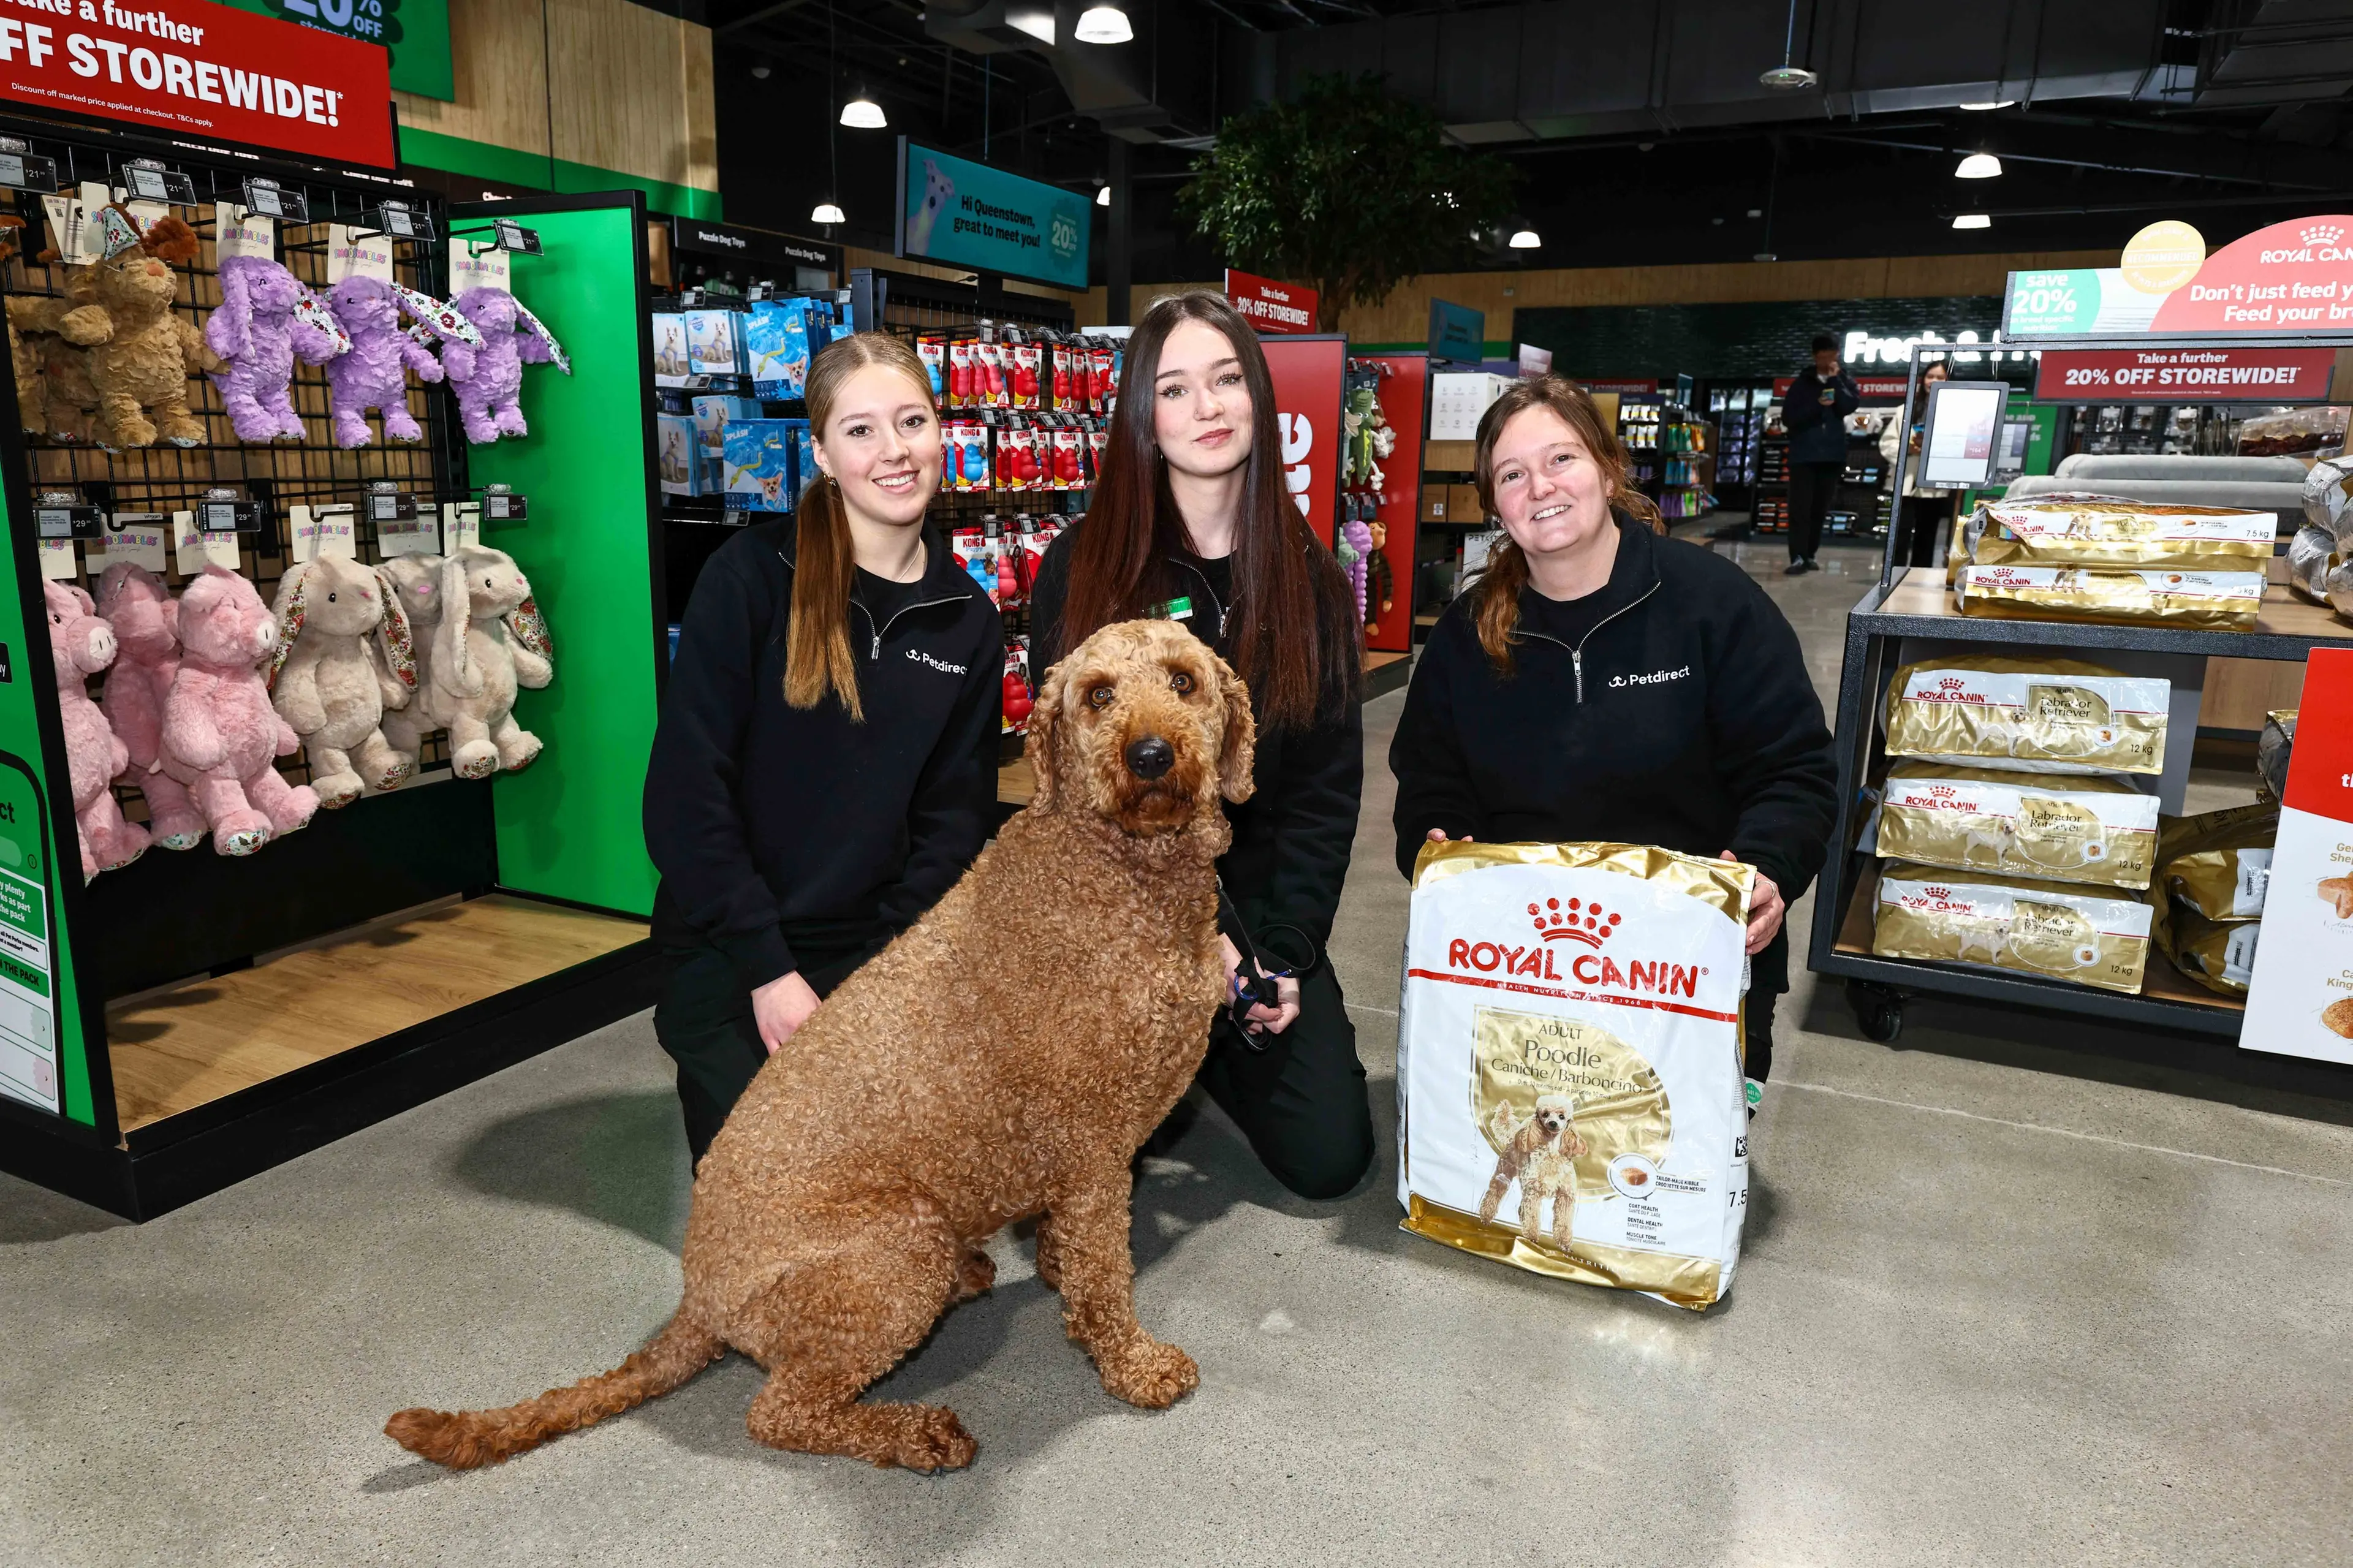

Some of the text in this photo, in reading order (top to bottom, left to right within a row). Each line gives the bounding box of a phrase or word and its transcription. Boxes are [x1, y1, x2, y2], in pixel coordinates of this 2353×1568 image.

[79, 0, 203, 46] a further
[353, 15, 382, 38] OFF
[11, 82, 45, 96] Discount
[58, 91, 86, 103] marked
[88, 97, 105, 107] price
[107, 100, 133, 112] applied
[143, 107, 175, 119] checkout.
[176, 114, 194, 123] T&Cs
[194, 117, 214, 127] apply.
[961, 195, 972, 211] Hi
[975, 199, 1036, 229] Queenstown,
[699, 231, 746, 248] Puzzle Dog Toys
[953, 217, 1040, 249] great to meet you!
[334, 248, 387, 265] SMOOSHABLES
[803, 249, 813, 260] Dog
[814, 252, 826, 262] Toys
[2126, 251, 2199, 264] RECOMMENDED
[2260, 248, 2314, 264] ROYAL
[2026, 273, 2069, 288] save
[1260, 286, 1271, 298] Take
[2190, 281, 2337, 303] Don't just feed
[1237, 297, 1268, 317] 20% OFF
[2010, 288, 2077, 314] 20%
[2224, 304, 2273, 322] Feed
[2276, 308, 2325, 324] your
[2137, 353, 2167, 364] Take
[2180, 352, 2229, 364] further
[2065, 368, 2110, 385] 20%
[2115, 368, 2155, 385] OFF
[725, 428, 749, 442] SPLASH
[298, 525, 349, 539] SMOOSHABLES
[1032, 532, 1050, 543] KONG
[2259, 529, 2269, 539] kg
[93, 534, 158, 547] SMOOSHABLES
[963, 538, 980, 547] KONG
[1976, 576, 2031, 586] ROYAL CANIN
[922, 653, 967, 676] Petdirec
[1629, 665, 1690, 686] Petdirect
[1917, 691, 1985, 703] ROYAL CANIN
[2040, 707, 2091, 718] Retriever
[2130, 744, 2153, 755] 12 kg
[1906, 795, 1977, 812] ROYAL CANIN
[2032, 810, 2082, 822] Labrador
[2130, 860, 2142, 871] kg
[5, 884, 25, 900] plenty
[9, 898, 31, 913] as part
[1901, 895, 1972, 914] ROYAL CANIN
[0, 904, 26, 923] the pack
[1449, 939, 1563, 982] ROYAL
[4, 961, 39, 987] THE PACK
[2122, 966, 2133, 976] kg
[1497, 982, 1529, 991] HEALTH
[1534, 987, 1582, 999] NUTRITION
[1585, 993, 1614, 1003] INCE
[2327, 978, 2353, 991] King
[1539, 1024, 1583, 1040] ADULT
[1525, 1039, 1602, 1069] Poodle
[1491, 1058, 1642, 1094] Caniche / Barboncino
[1656, 1175, 1684, 1184] TAILOR-MADE
[1729, 1189, 1747, 1208] 7.5
